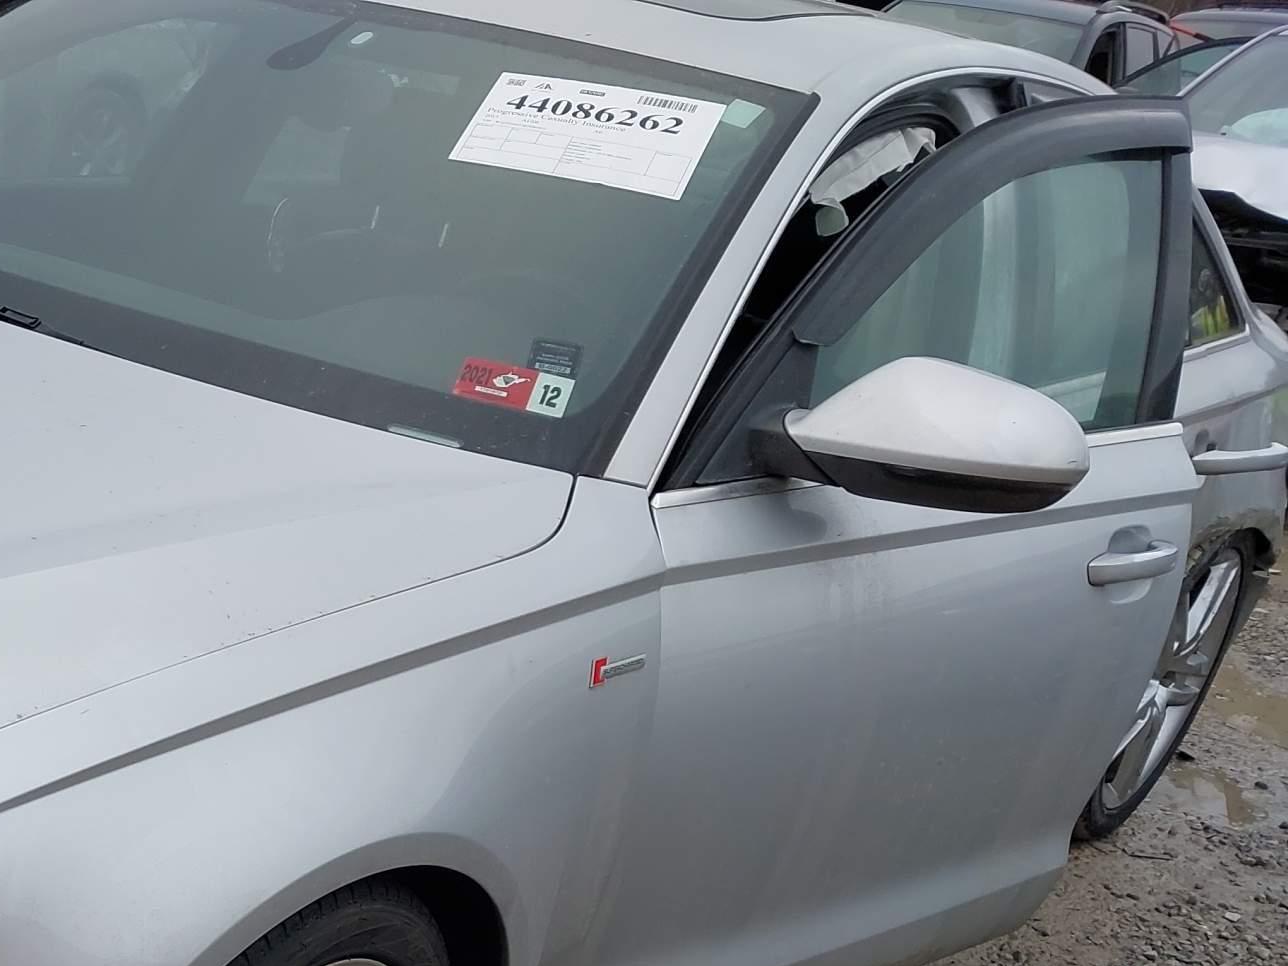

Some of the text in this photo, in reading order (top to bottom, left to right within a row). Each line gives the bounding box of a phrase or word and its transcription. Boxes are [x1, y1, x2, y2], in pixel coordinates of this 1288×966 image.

[506, 95, 684, 135] 44086262
[462, 364, 493, 386] 2021
[539, 384, 562, 408] 12
